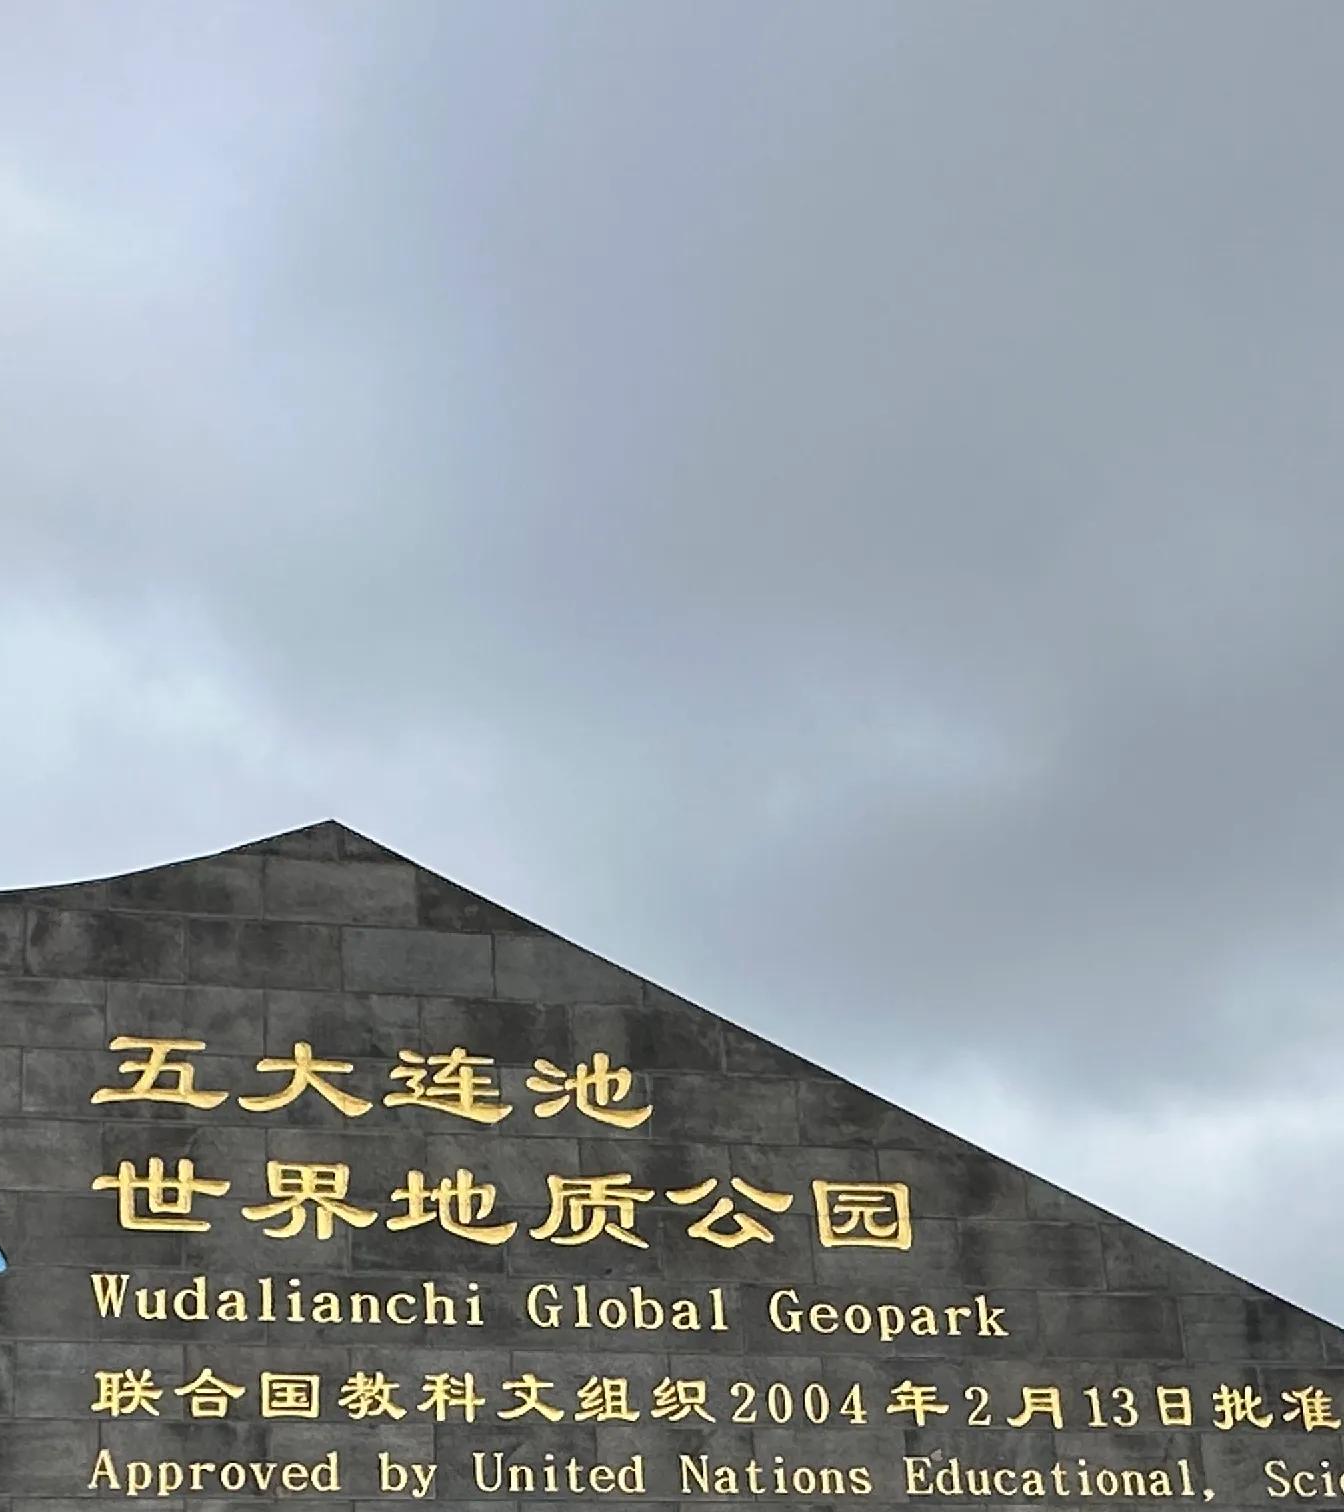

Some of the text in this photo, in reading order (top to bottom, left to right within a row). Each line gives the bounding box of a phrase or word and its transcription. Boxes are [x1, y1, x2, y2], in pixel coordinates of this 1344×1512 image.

[90, 1036, 654, 1129] 五大连池
[91, 1157, 912, 1250] 世界地质公园
[90, 1274, 1009, 1342] Wudalianchi Global Geopark
[90, 1368, 1342, 1432] 联合国教科文组织2004年2月13日批准
[87, 1448, 342, 1497] Approved
[378, 1451, 438, 1498] by
[472, 1452, 646, 1494] United
[679, 1454, 872, 1494] Nations
[902, 1456, 1216, 1502] Educational,
